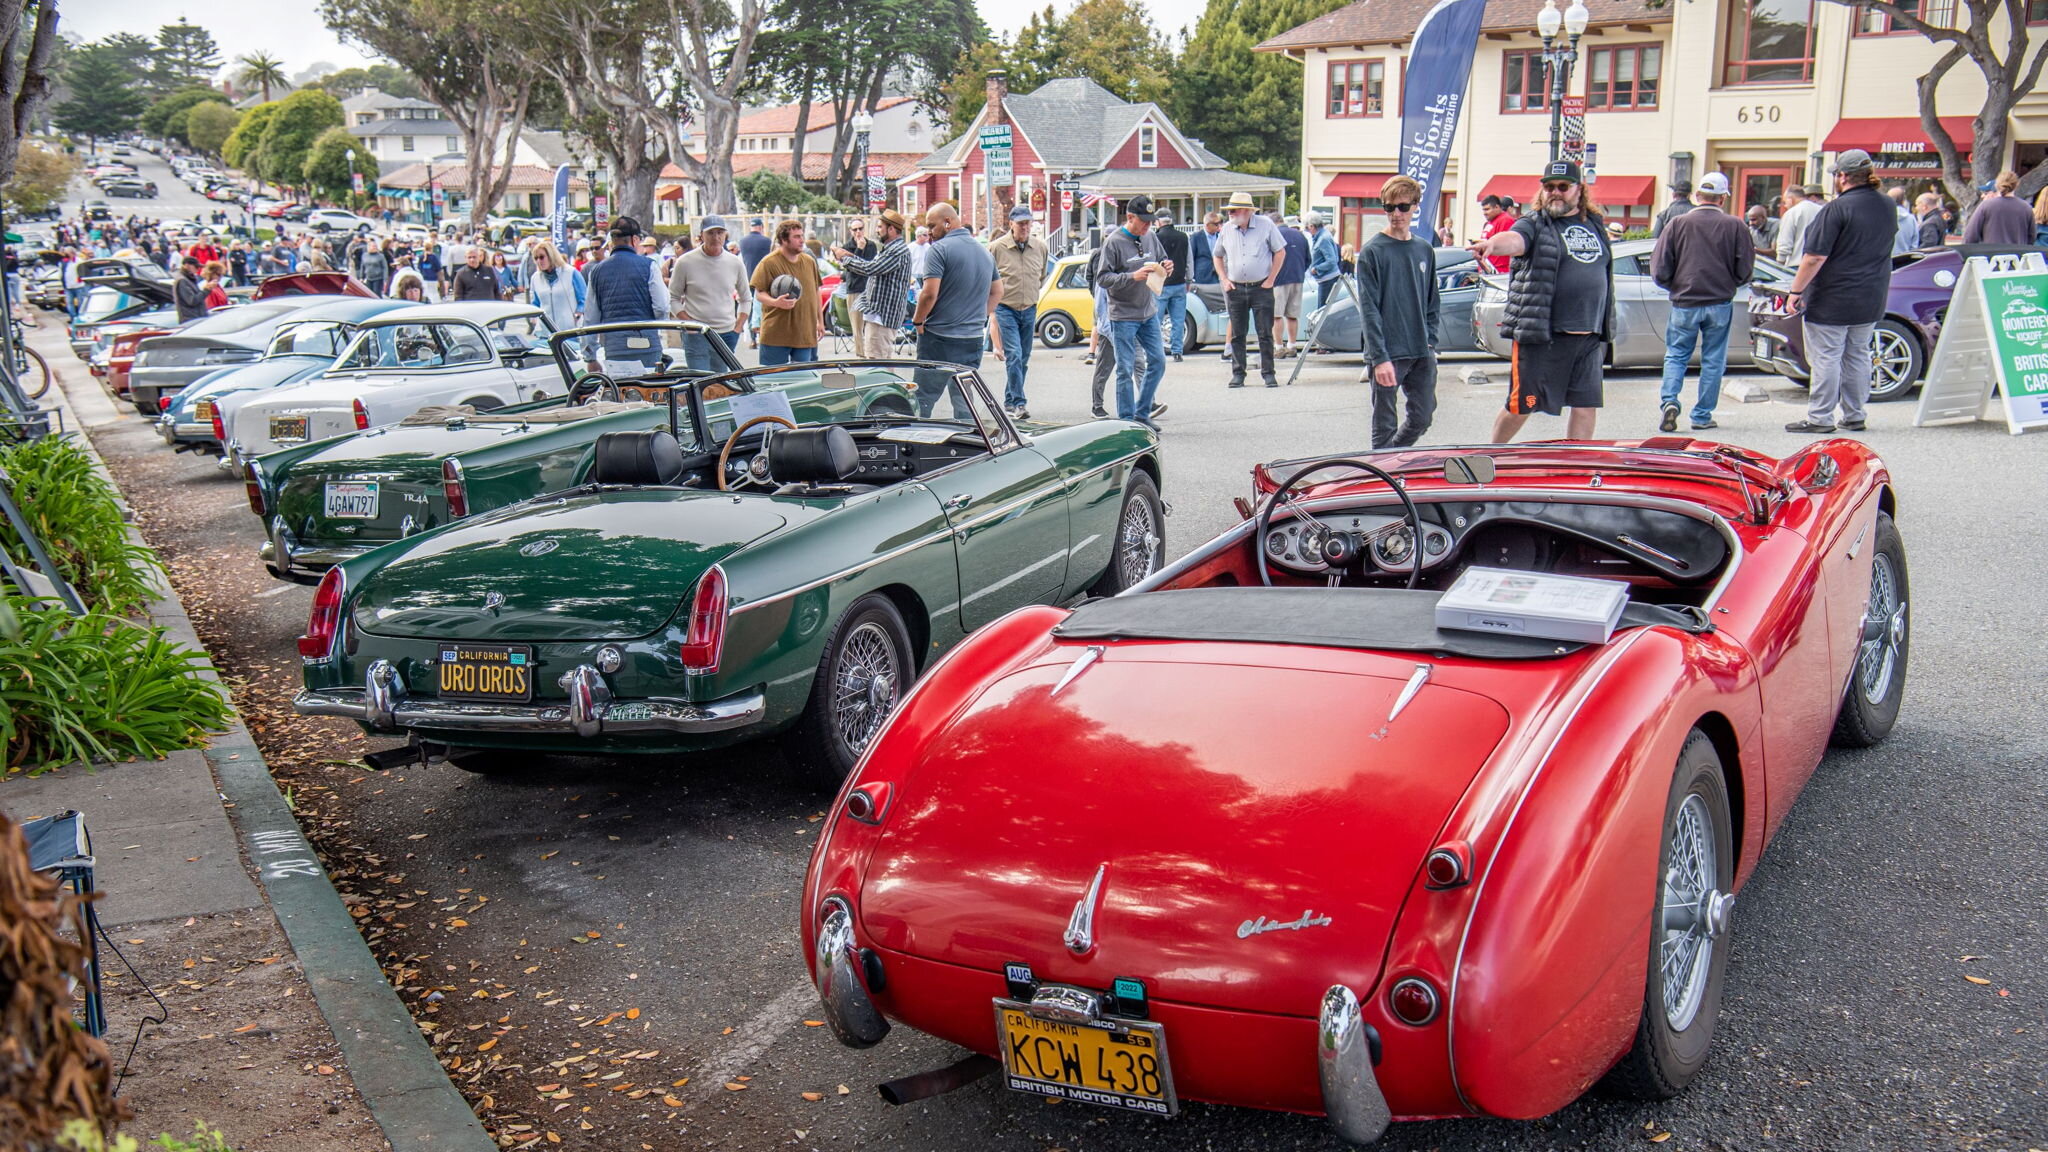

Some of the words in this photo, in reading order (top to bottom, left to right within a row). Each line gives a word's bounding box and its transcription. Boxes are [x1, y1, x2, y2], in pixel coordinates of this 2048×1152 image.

[1440, 93, 1459, 149] magazine
[1737, 106, 1781, 124] 650
[1881, 142, 1925, 153] AURELIA'S
[328, 495, 375, 513] 4GAW797
[444, 652, 456, 660] SEP
[460, 651, 508, 660] CALIFORNIA
[441, 663, 475, 692] URO
[480, 665, 526, 694] OROS
[1010, 967, 1031, 980] AUG
[1120, 984, 1138, 992] 2022
[1007, 1014, 1080, 1037] CALIFORNIA
[1127, 1035, 1146, 1046] 56
[1010, 1031, 1084, 1086] KCW
[1098, 1046, 1162, 1096] 438
[1010, 1078, 1066, 1097] BRITISH
[1069, 1088, 1122, 1106] MOTOR
[1126, 1098, 1168, 1113] CARS
